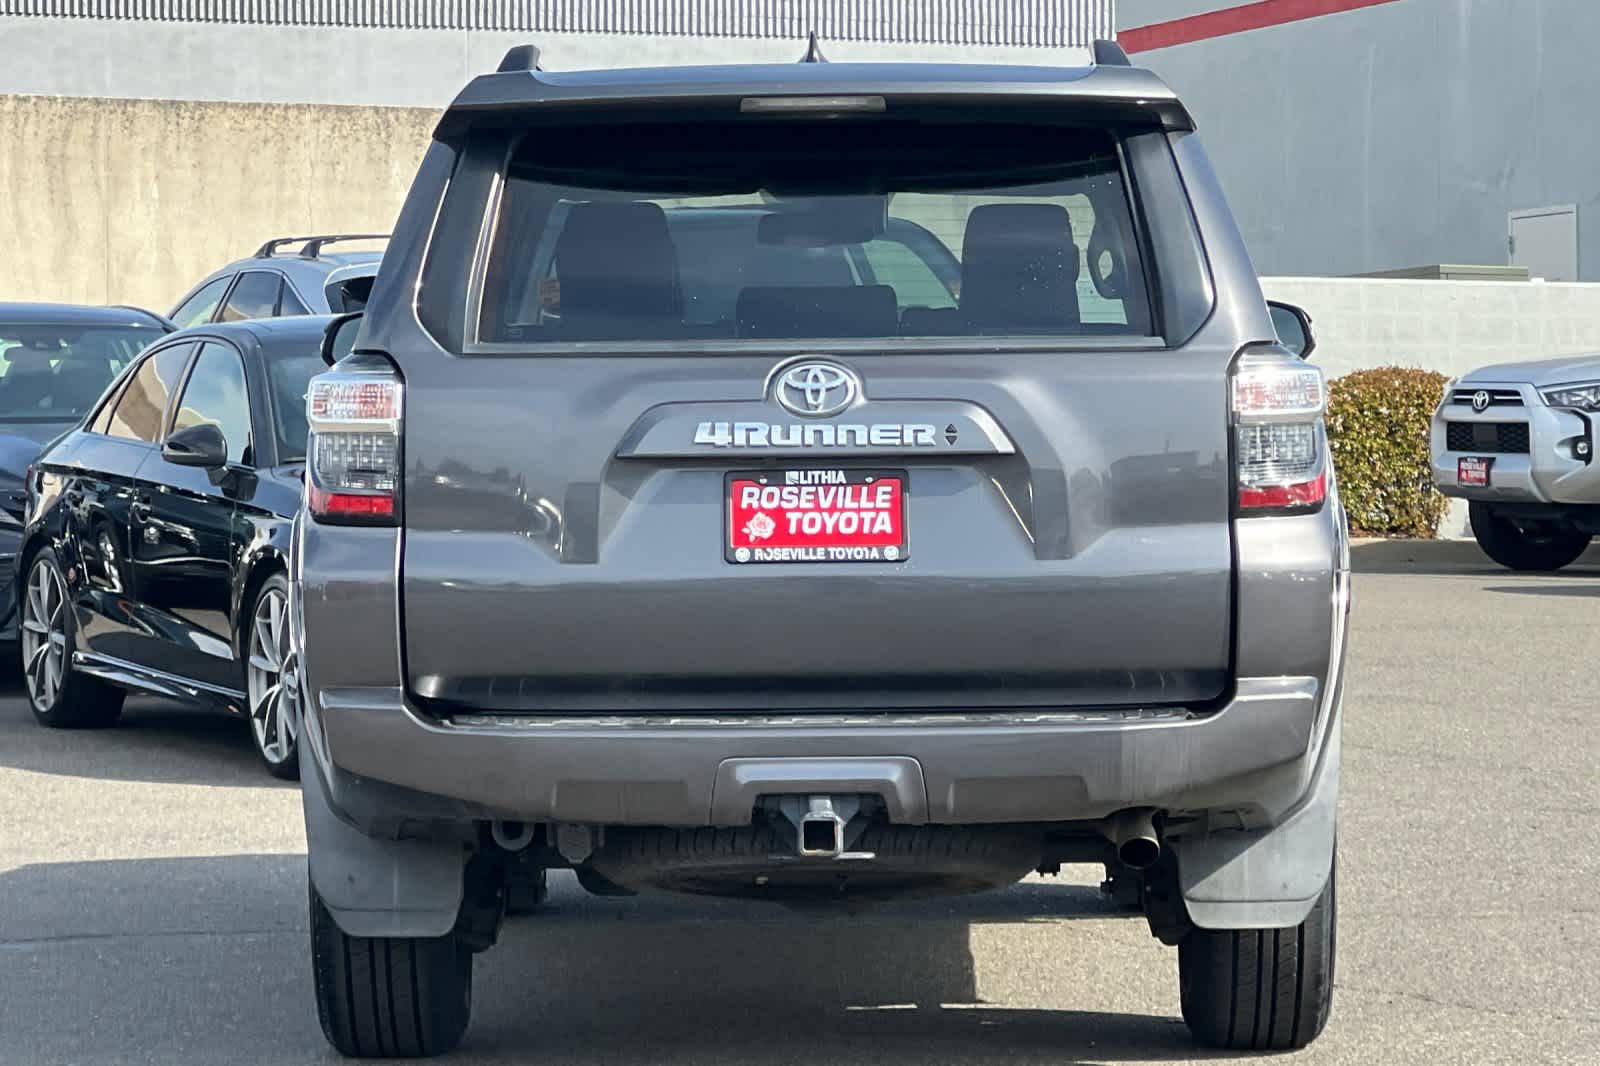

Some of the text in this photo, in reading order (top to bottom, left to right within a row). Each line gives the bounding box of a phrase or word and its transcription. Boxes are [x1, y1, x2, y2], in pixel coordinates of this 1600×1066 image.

[693, 421, 937, 447] 4RUNNER
[800, 470, 847, 485] LITHIA
[741, 486, 893, 509] ROSEVILLE
[786, 511, 893, 534] TOYOTA
[755, 547, 880, 561] ROSEVILLE TOYOTA
